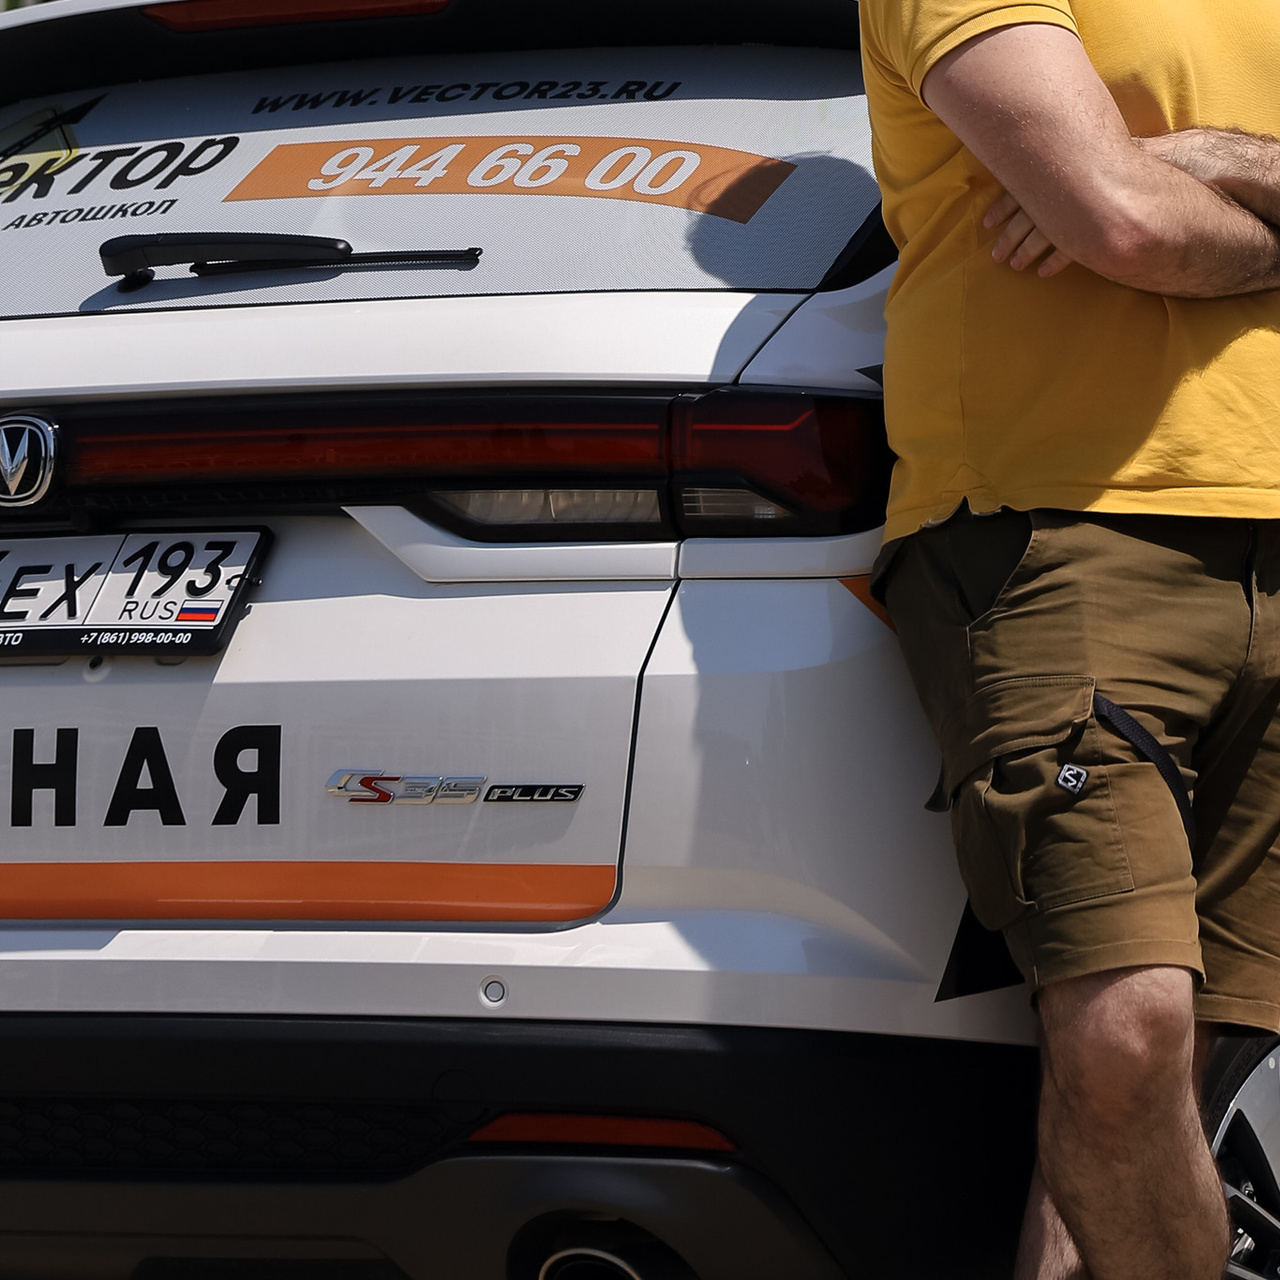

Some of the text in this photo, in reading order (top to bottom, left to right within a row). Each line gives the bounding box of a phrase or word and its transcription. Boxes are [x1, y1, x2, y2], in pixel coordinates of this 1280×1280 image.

[251, 81, 682, 115] WWW.VECTOR23.RU
[307, 143, 702, 196] 944 66 00
[2, 198, 179, 231] АВТОШКОЛ
[122, 541, 237, 599] 193
[118, 600, 177, 621] RUS
[80, 631, 192, 645] +7 (861) 998-00-00
[10, 724, 282, 828] НАЯ
[487, 785, 582, 802] PLUS
